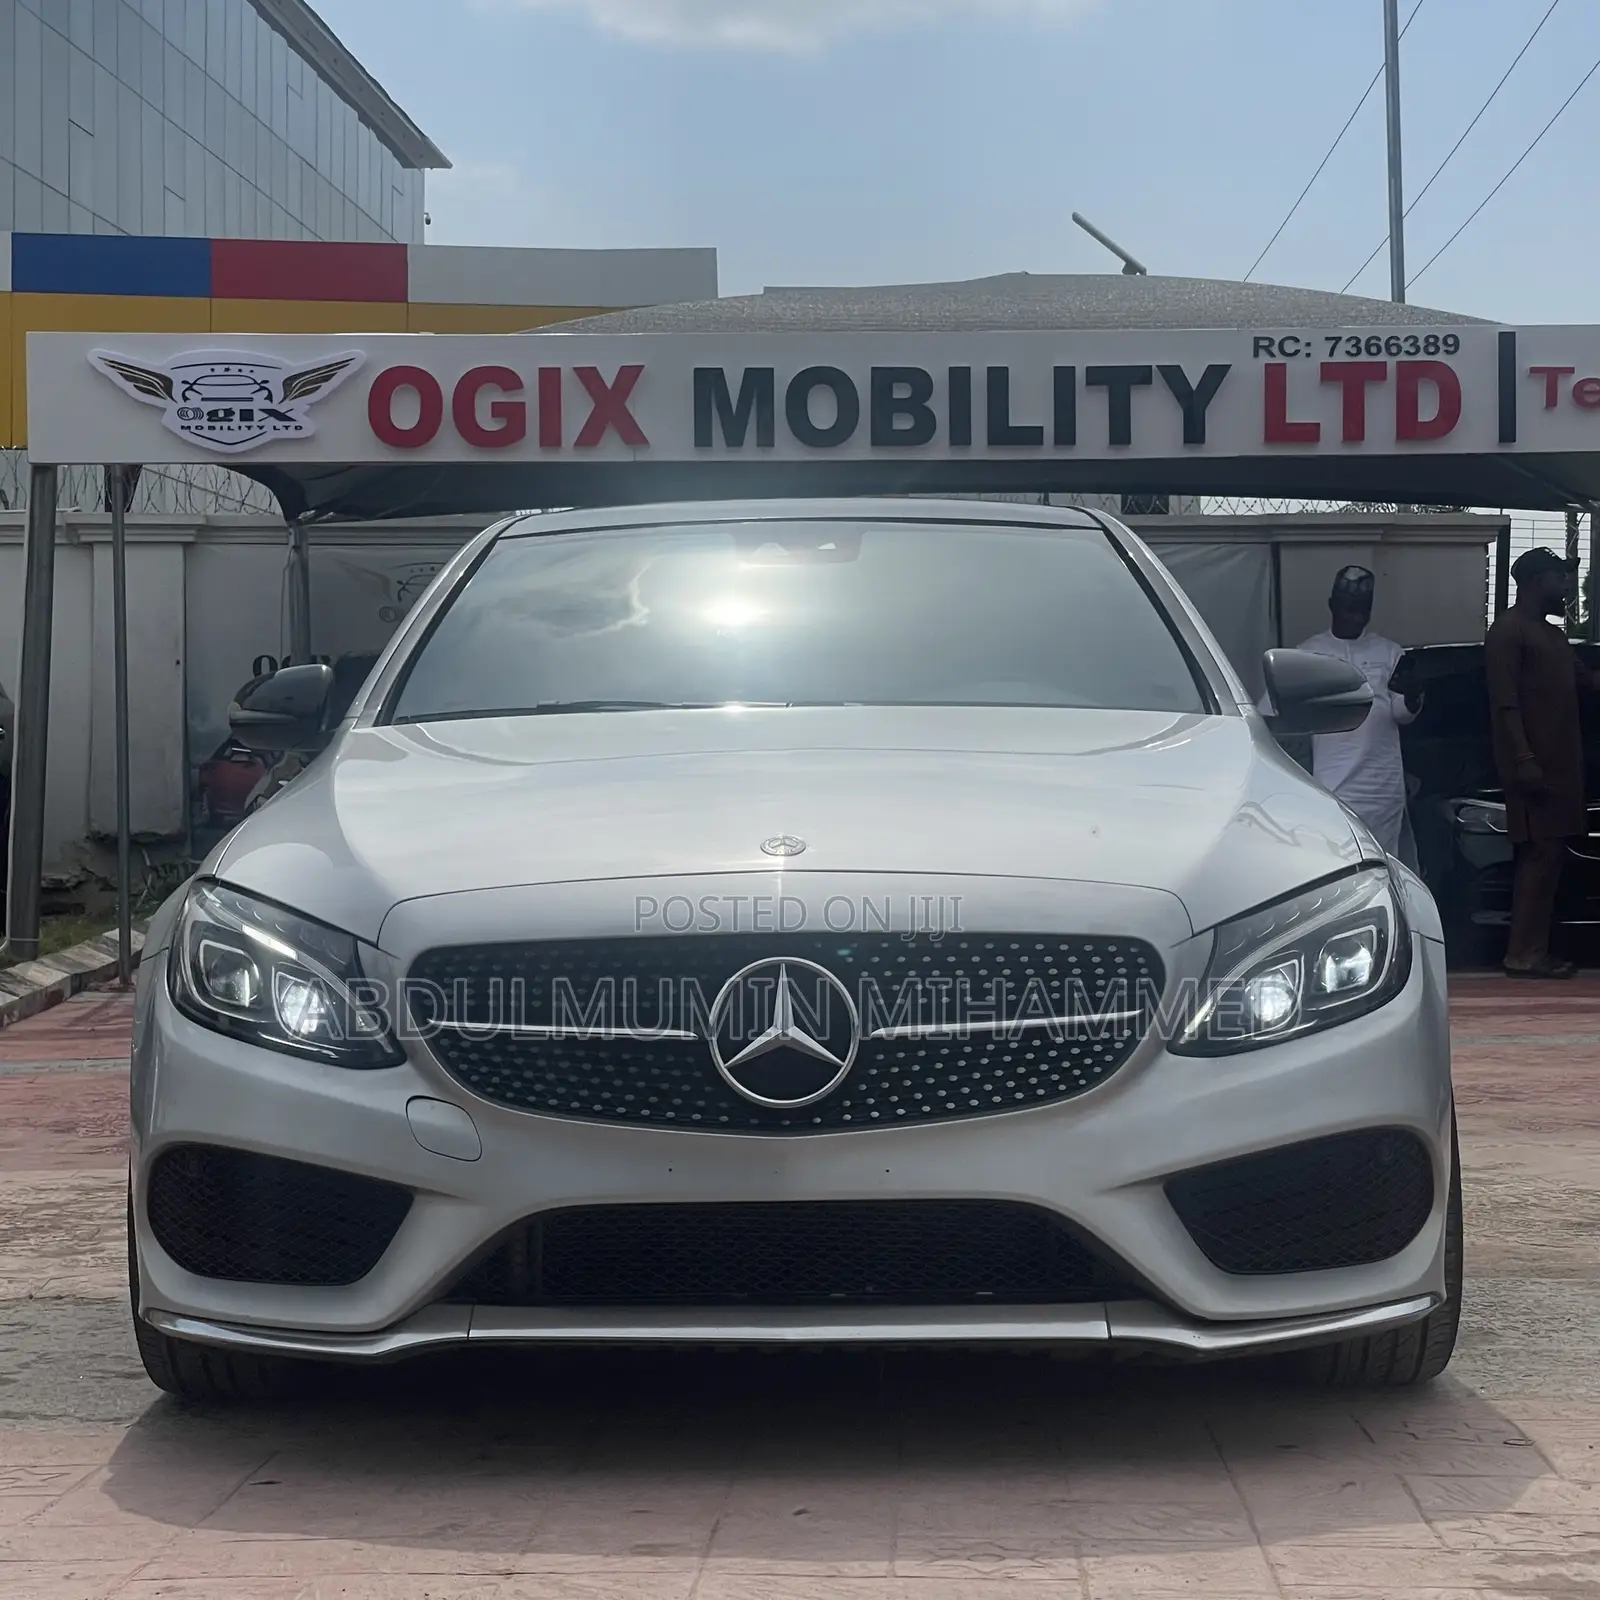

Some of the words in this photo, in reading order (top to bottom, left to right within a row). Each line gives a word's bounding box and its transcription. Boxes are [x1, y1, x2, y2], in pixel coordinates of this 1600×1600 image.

[1252, 336, 1312, 358] RC:
[1324, 333, 1460, 357] 7366389
[367, 364, 650, 449] OGIX
[693, 364, 1232, 448] MOBILITY
[1264, 360, 1462, 443] LTD
[180, 424, 265, 432] MOBILITY
[272, 424, 304, 432] LTD
